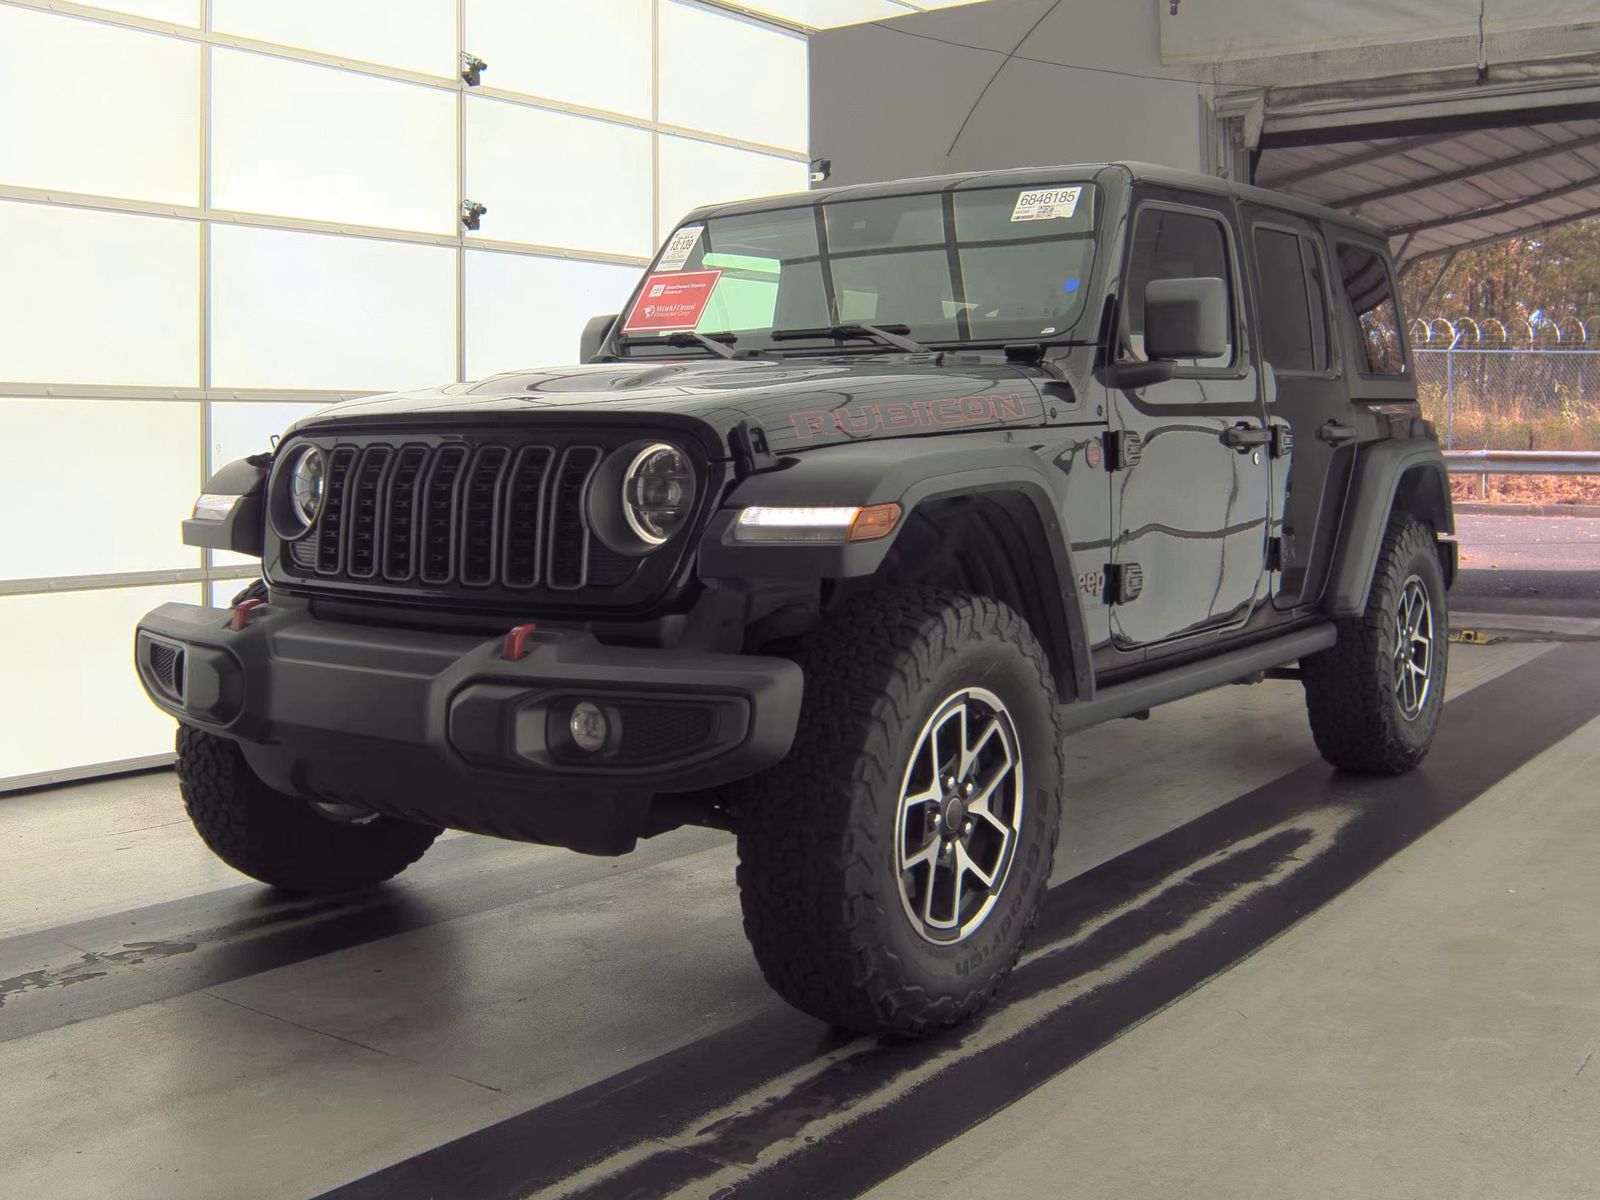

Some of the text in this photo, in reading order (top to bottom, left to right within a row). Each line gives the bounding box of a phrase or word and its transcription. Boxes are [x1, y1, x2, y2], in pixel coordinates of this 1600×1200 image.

[1020, 191, 1076, 206] 6848185
[789, 393, 1026, 440] RUBICON
[1078, 571, 1104, 597] eep
